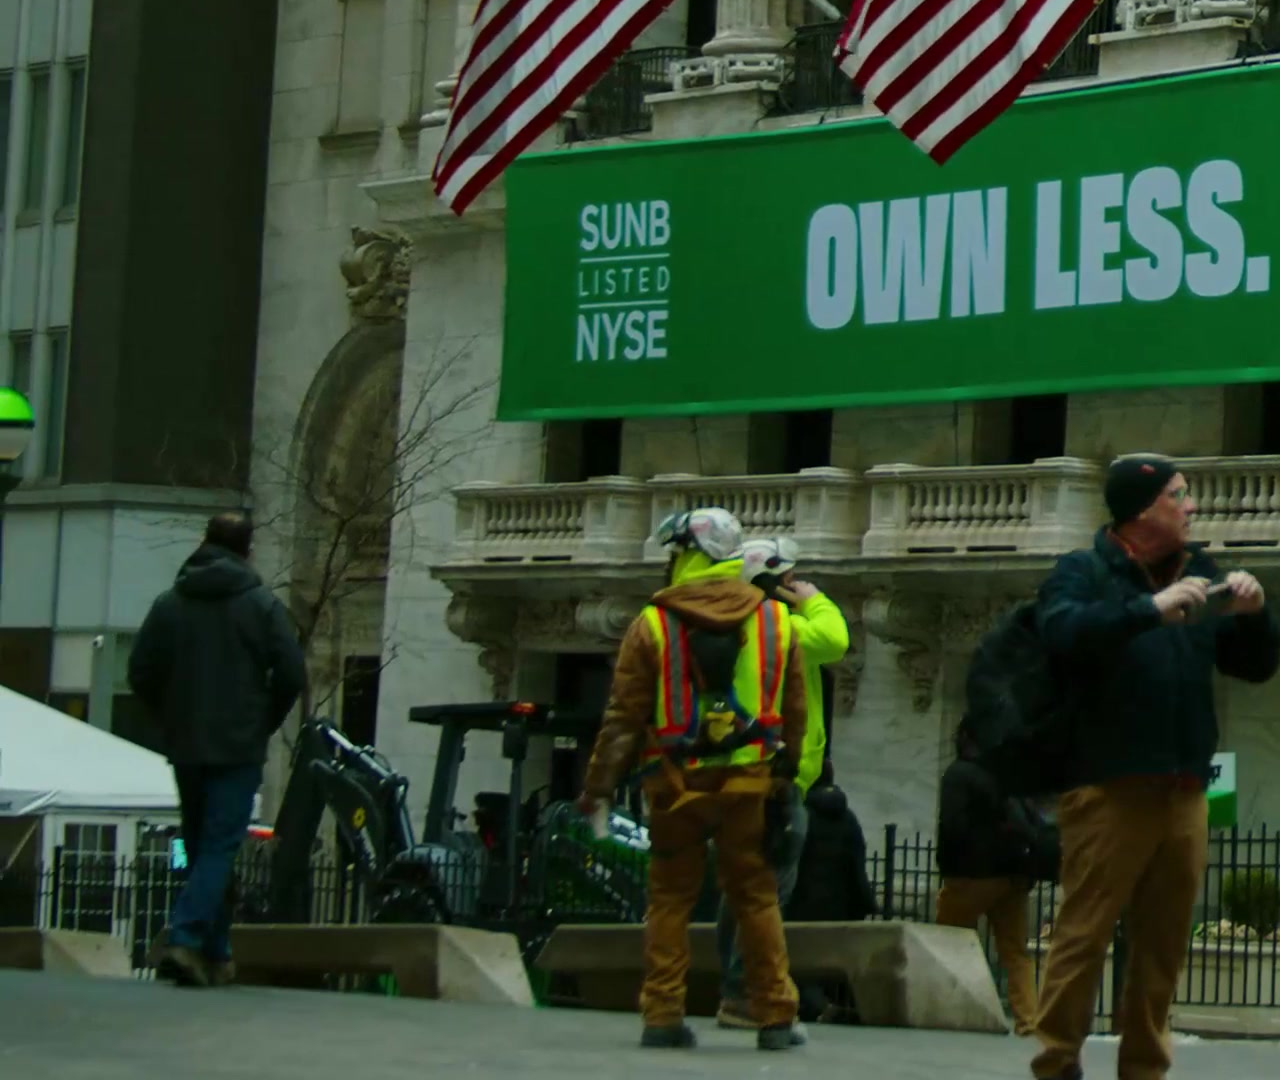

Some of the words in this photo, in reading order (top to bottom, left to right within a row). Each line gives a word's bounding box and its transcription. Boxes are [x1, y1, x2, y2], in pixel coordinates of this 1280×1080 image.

[580, 200, 671, 251] SUNB
[807, 188, 1006, 329] OWN
[1036, 160, 1269, 308] LESS.
[578, 266, 671, 298] LISTED
[575, 309, 668, 361] NYSE
